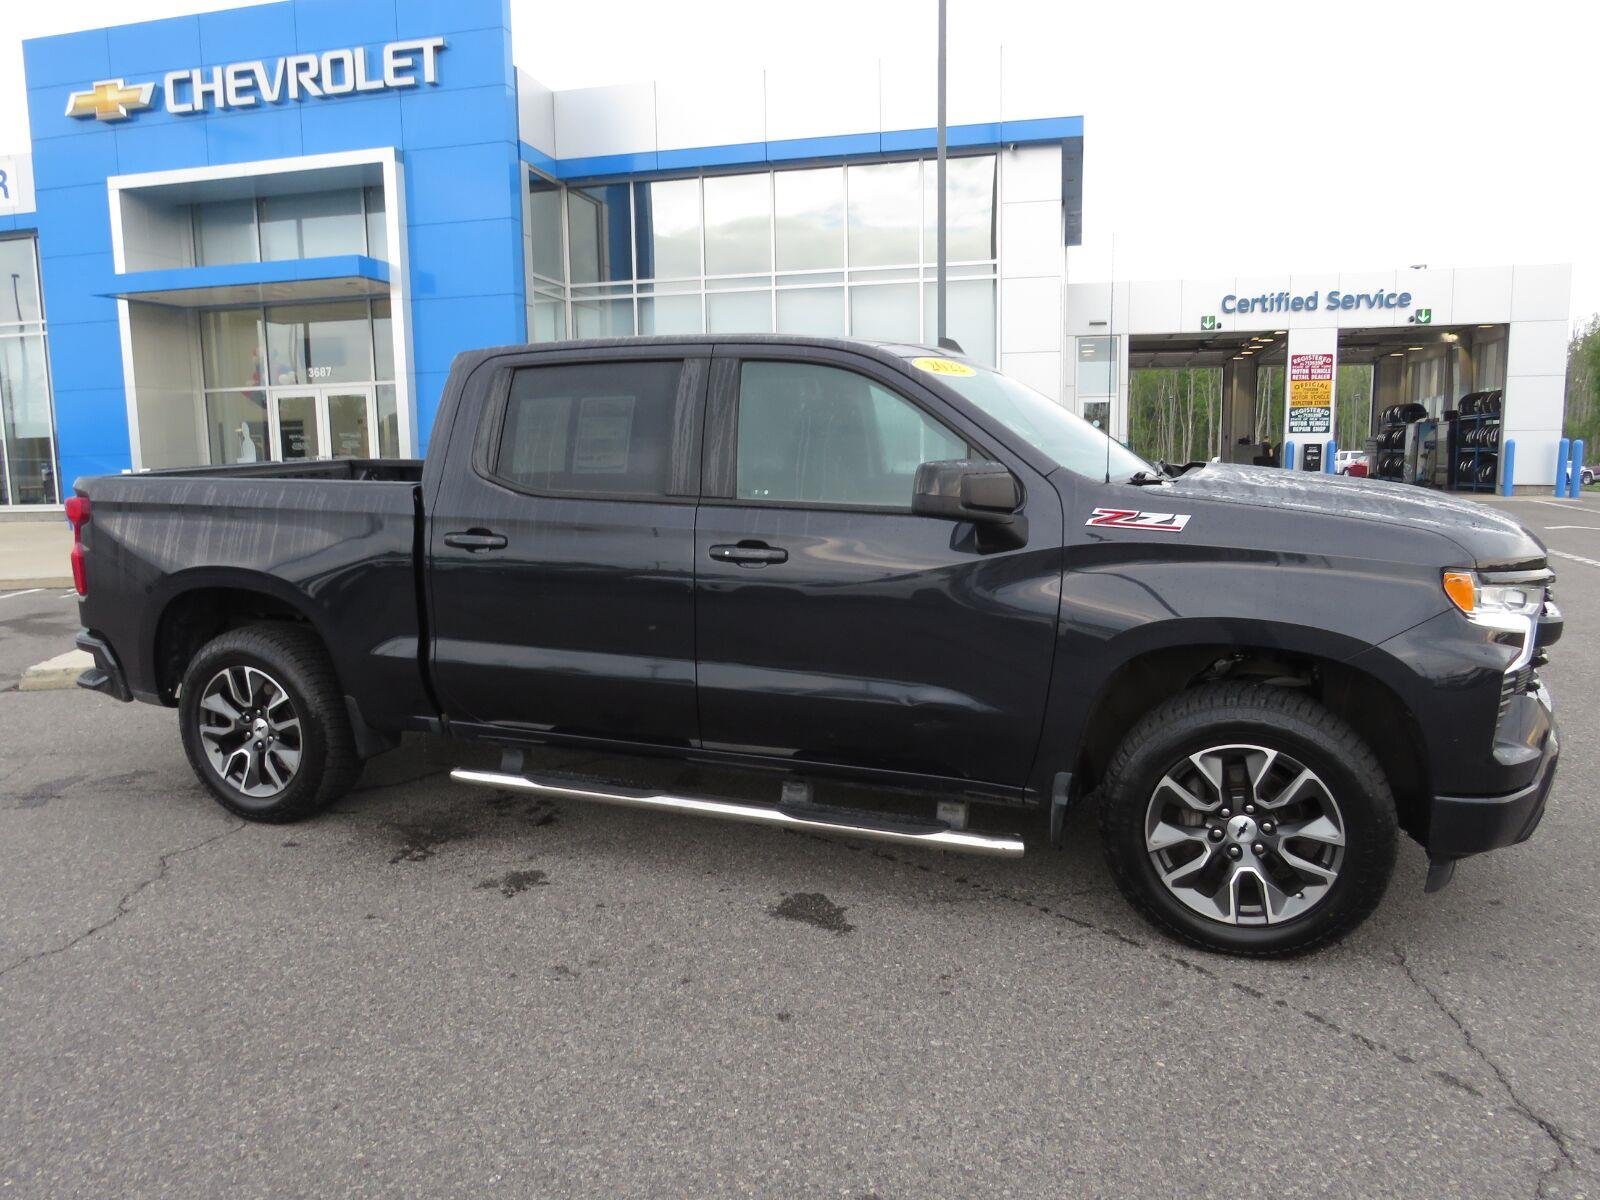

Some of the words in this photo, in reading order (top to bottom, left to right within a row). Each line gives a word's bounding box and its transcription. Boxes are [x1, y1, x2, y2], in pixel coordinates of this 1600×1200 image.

[164, 36, 444, 114] CHEVROLET
[1221, 291, 1318, 314] Certified
[1326, 289, 1412, 311] Service
[1293, 354, 1332, 364] REGISTERED
[308, 367, 332, 378] 3687
[1294, 382, 1328, 390] OFFICIAL
[1291, 408, 1330, 416] REGISTERED
[1085, 508, 1192, 532] Z71
